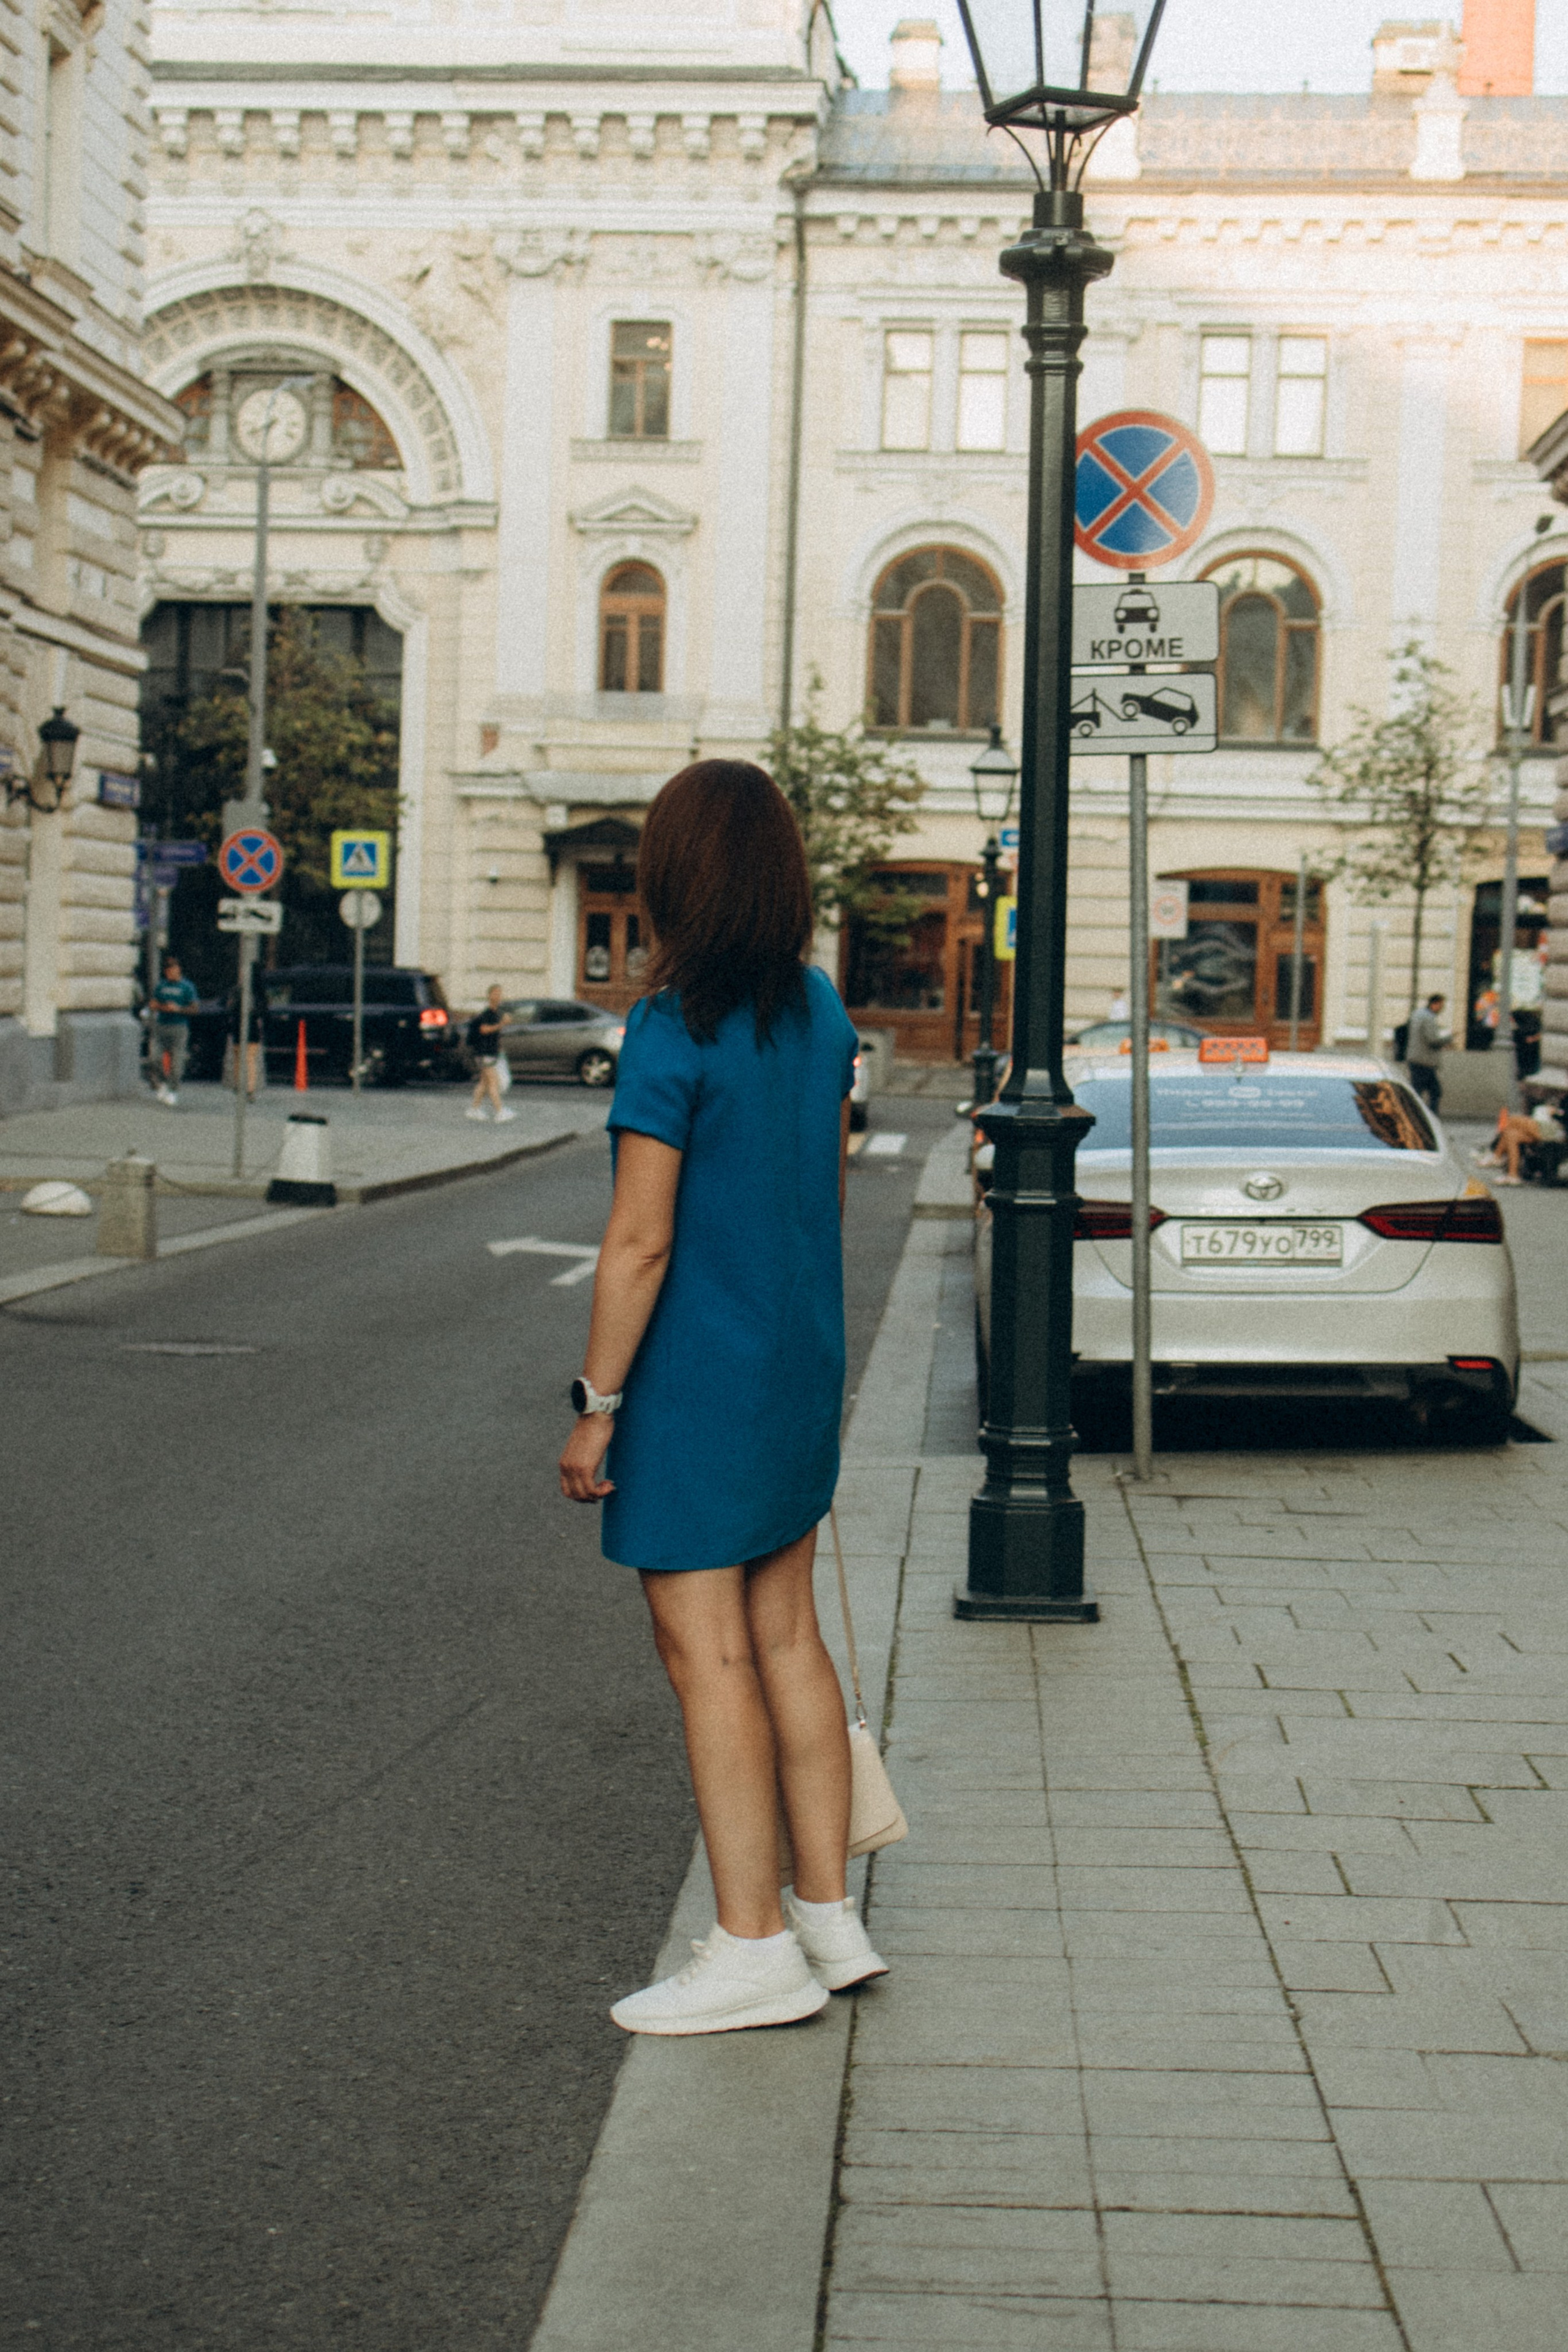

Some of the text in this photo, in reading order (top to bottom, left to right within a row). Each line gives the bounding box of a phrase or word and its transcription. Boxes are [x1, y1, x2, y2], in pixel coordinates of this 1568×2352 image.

[1091, 637, 1183, 659] КРОМЕ
[1193, 1229, 1335, 1254] Т679УО 799
